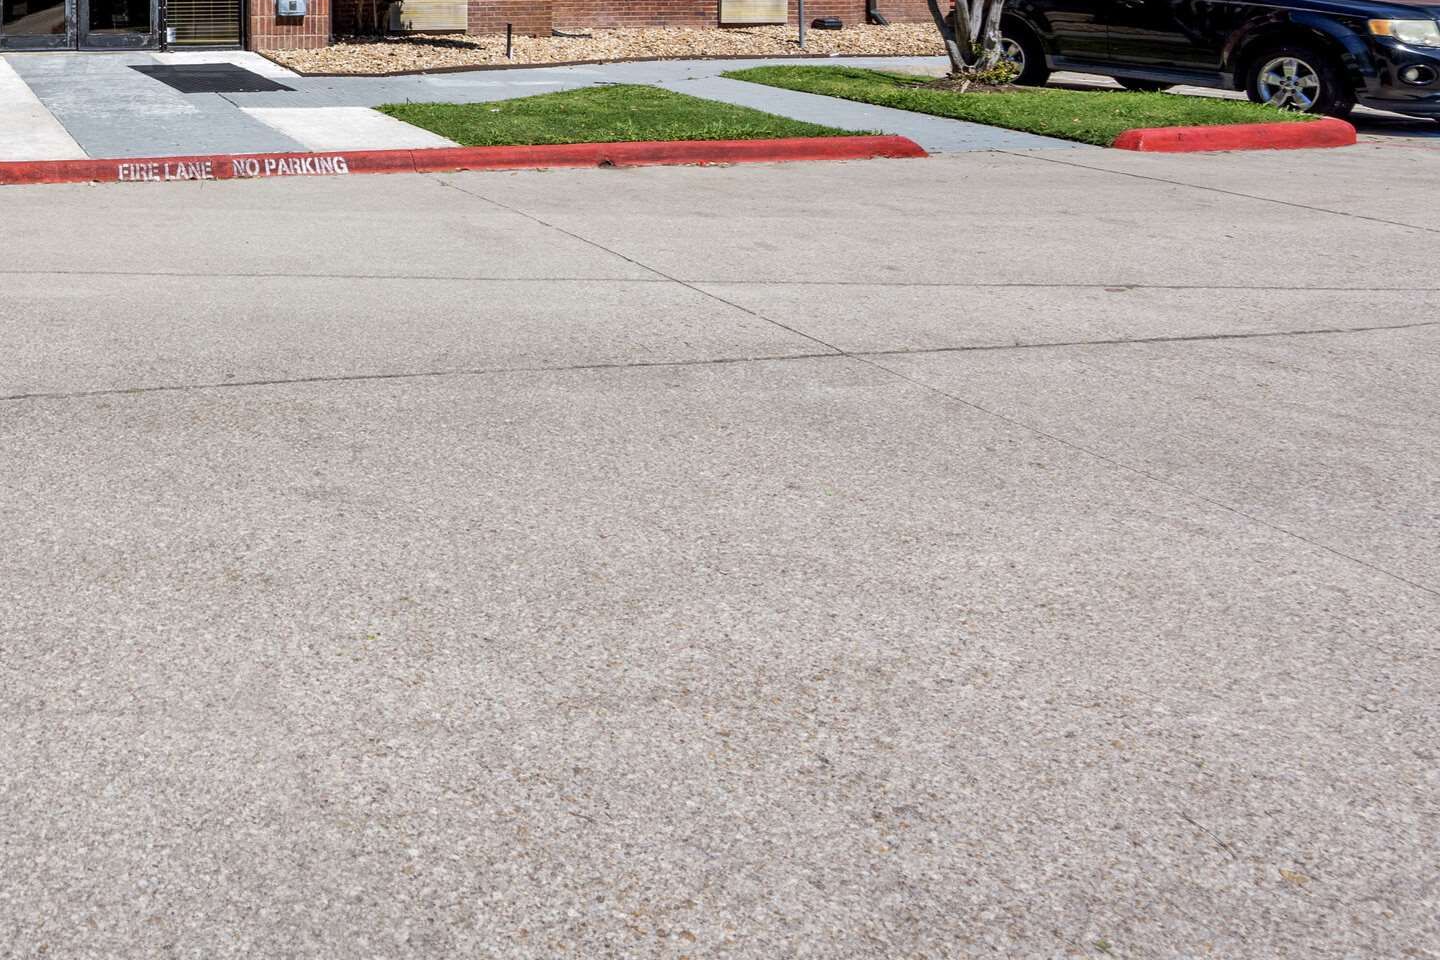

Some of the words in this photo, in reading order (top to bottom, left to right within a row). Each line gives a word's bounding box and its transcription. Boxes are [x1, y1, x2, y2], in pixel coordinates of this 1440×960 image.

[118, 163, 160, 181] FIRE
[164, 161, 213, 180] LANE
[232, 159, 260, 176] NO
[264, 157, 349, 176] PARKING
